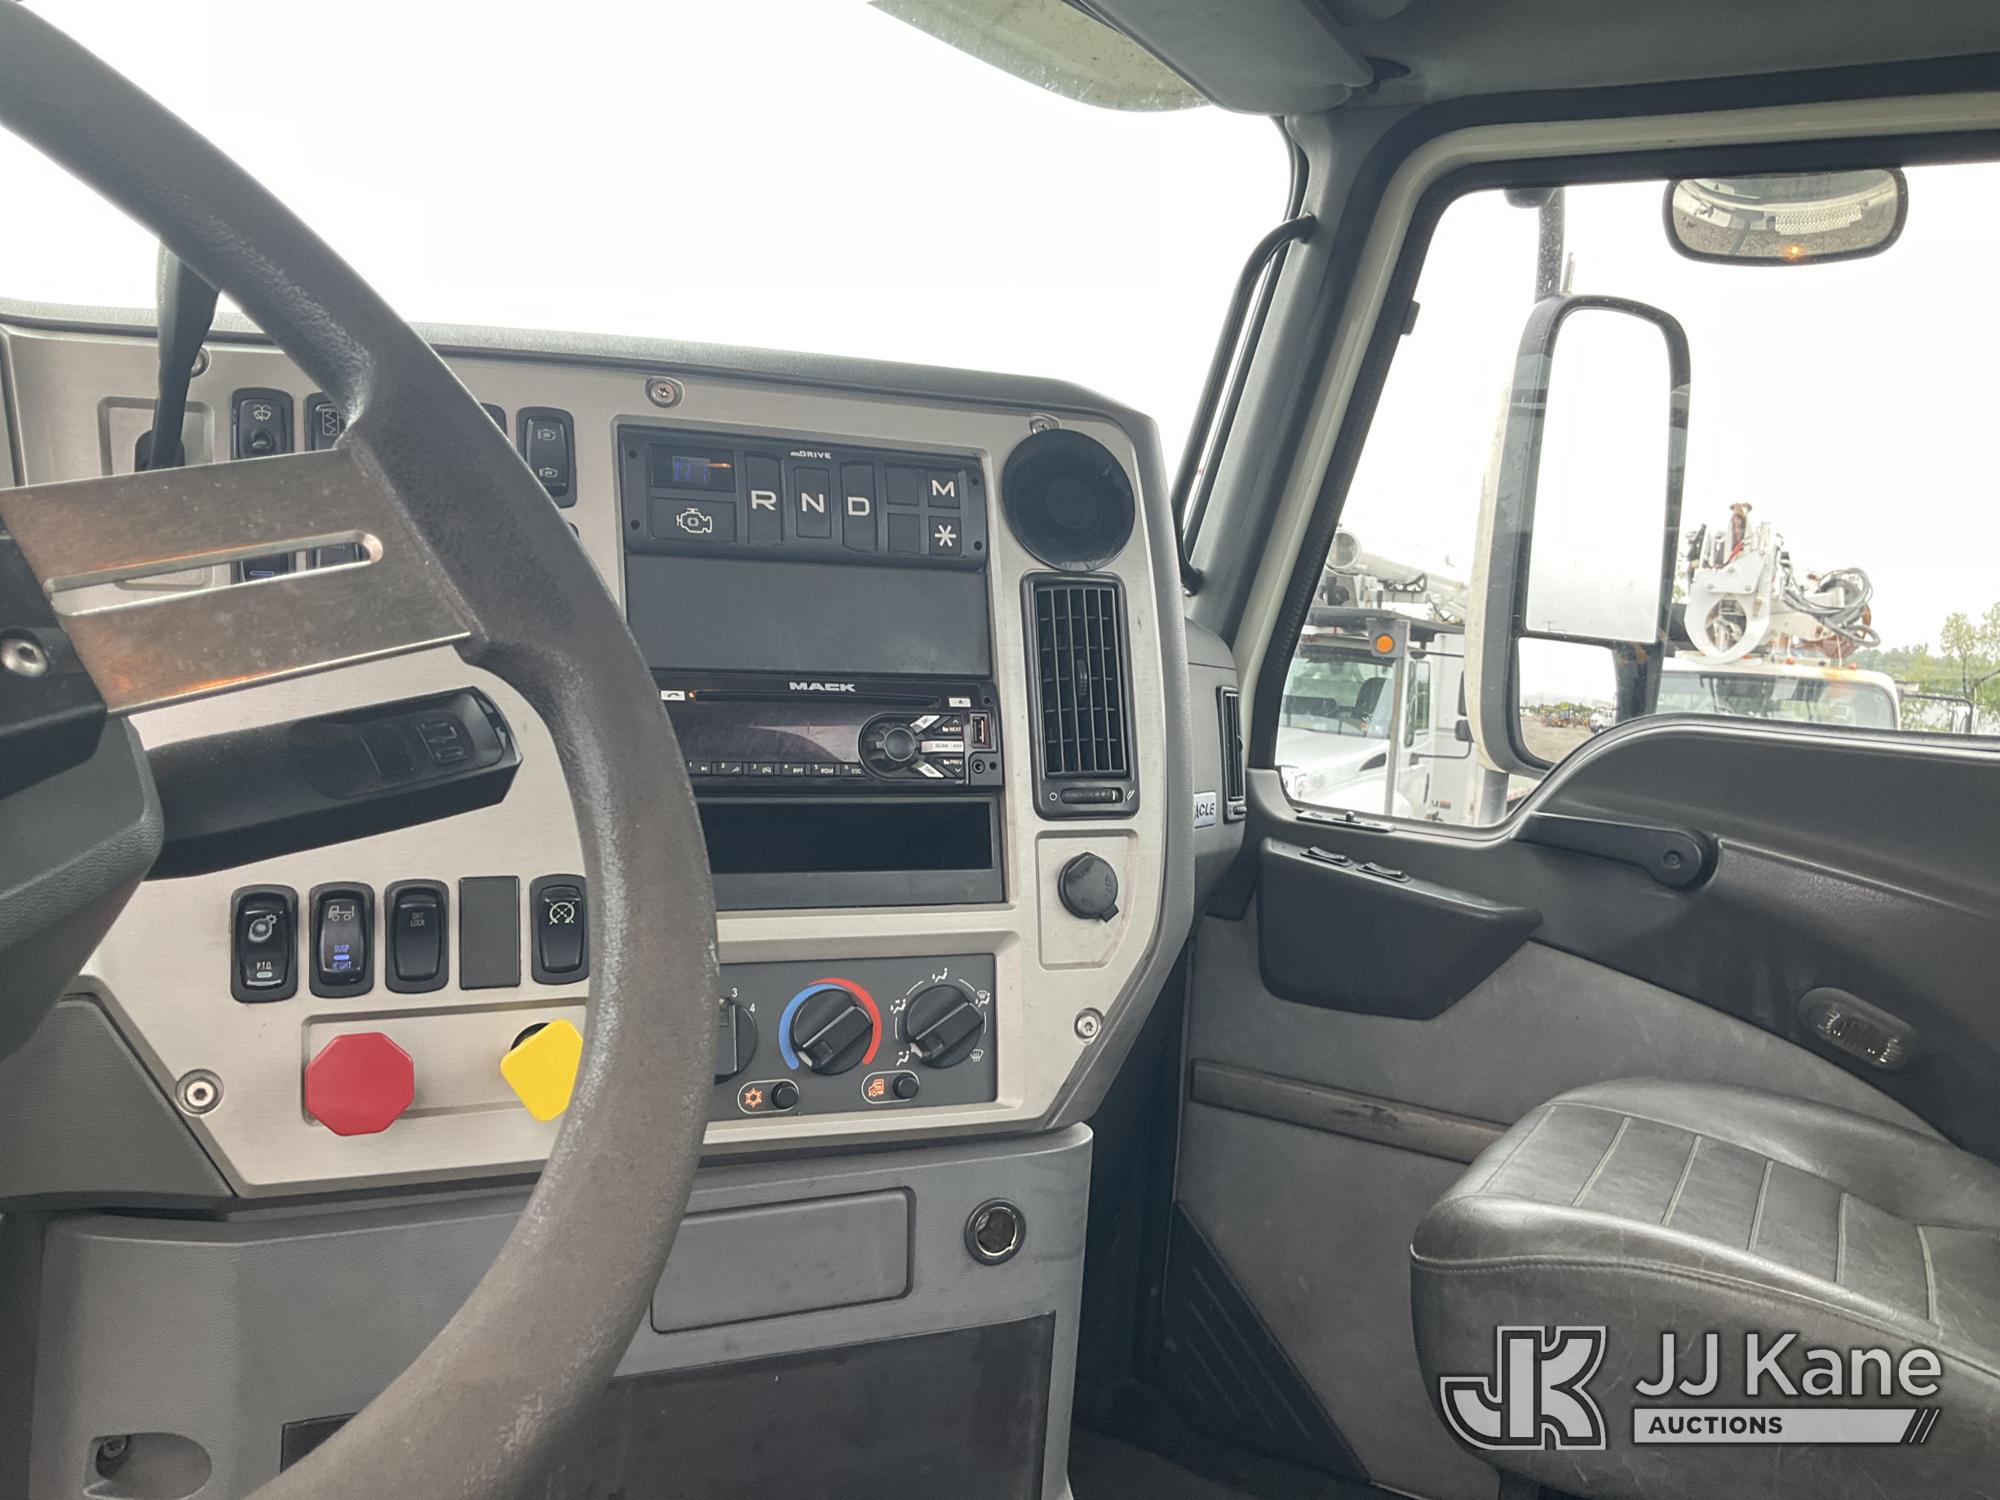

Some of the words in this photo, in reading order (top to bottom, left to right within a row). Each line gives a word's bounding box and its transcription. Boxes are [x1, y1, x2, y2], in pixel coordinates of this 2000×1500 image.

[790, 450, 832, 459] mDRIVE
[931, 479, 956, 498] M
[751, 490, 777, 511] R
[801, 493, 825, 513] N
[847, 496, 870, 516] D
[789, 681, 856, 693] MACK
[1193, 801, 1215, 821] ACLE
[732, 988, 738, 998] 3
[749, 1003, 755, 1012] 4
